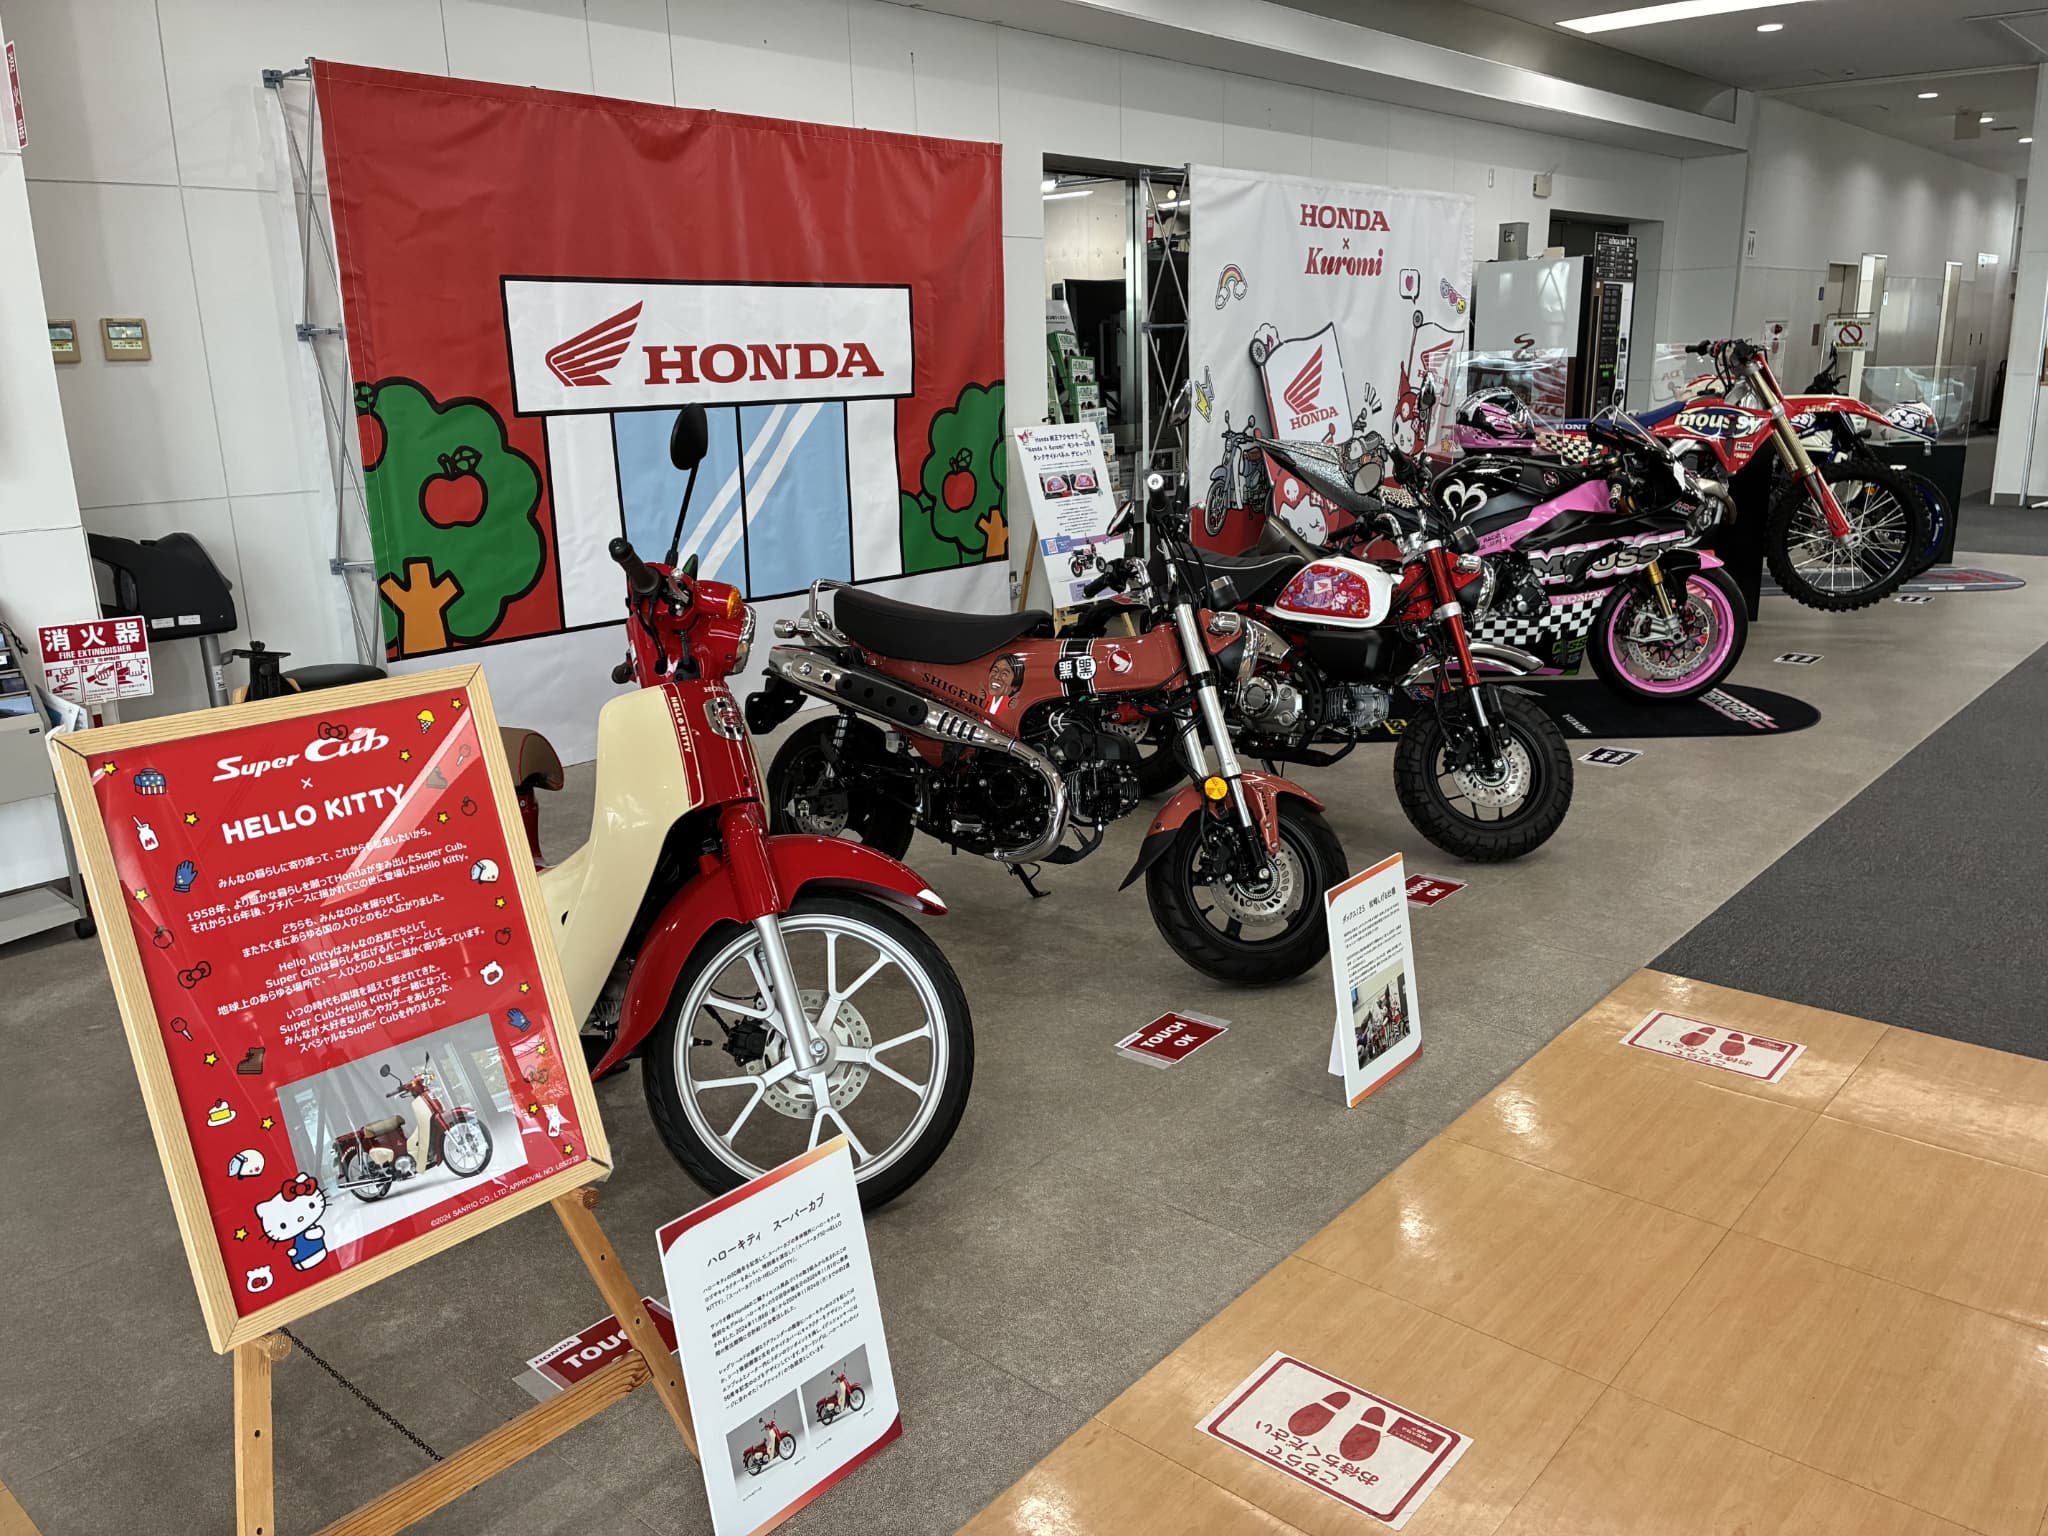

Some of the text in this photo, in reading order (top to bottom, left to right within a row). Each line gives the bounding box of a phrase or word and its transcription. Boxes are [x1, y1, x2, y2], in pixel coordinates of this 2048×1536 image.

[1300, 204, 1390, 231] HONDA
[1304, 247, 1384, 276] Kuromi
[643, 343, 884, 385] HONDA
[1289, 406, 1339, 430] HONDA
[44, 621, 140, 653] 消火器
[59, 645, 132, 660] FIRE EXTINGUISHER
[670, 696, 692, 752] HELLO KITTY
[213, 727, 390, 781] Super Cub
[222, 784, 405, 845] HELLO KITTY
[1426, 888, 1445, 897] OK
[278, 958, 307, 973] Hello
[265, 972, 298, 989] Super
[279, 1019, 311, 1035] Super
[1140, 1022, 1188, 1048] TOUCH
[1173, 1034, 1200, 1047] OK
[452, 1201, 479, 1217] SANRIO
[509, 1172, 543, 1192] APPROVAL
[707, 1192, 825, 1268] ハローキティ スーパーカブ
[533, 1340, 575, 1365] HONDA
[563, 1328, 628, 1369] TOU
[1255, 1420, 1380, 1486] お待ちください
[1266, 1446, 1339, 1486] こちらで
